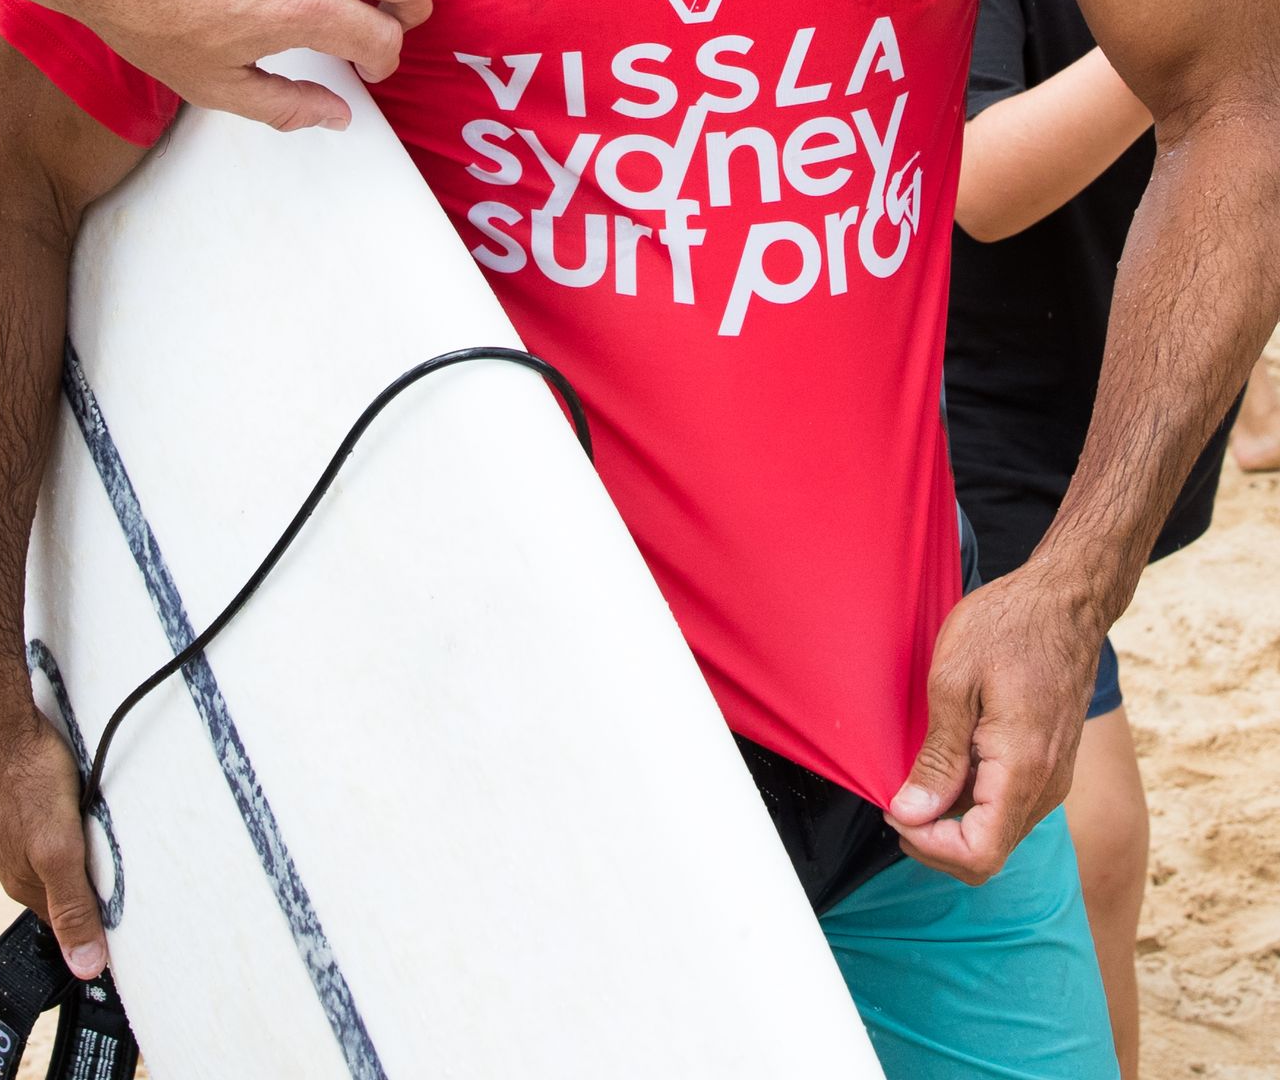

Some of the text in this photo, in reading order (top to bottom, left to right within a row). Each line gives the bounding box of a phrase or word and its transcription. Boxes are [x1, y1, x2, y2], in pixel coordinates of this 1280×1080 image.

[453, 16, 907, 119] VISSLA
[461, 91, 909, 218] sydney
[467, 198, 912, 337] surf pro
